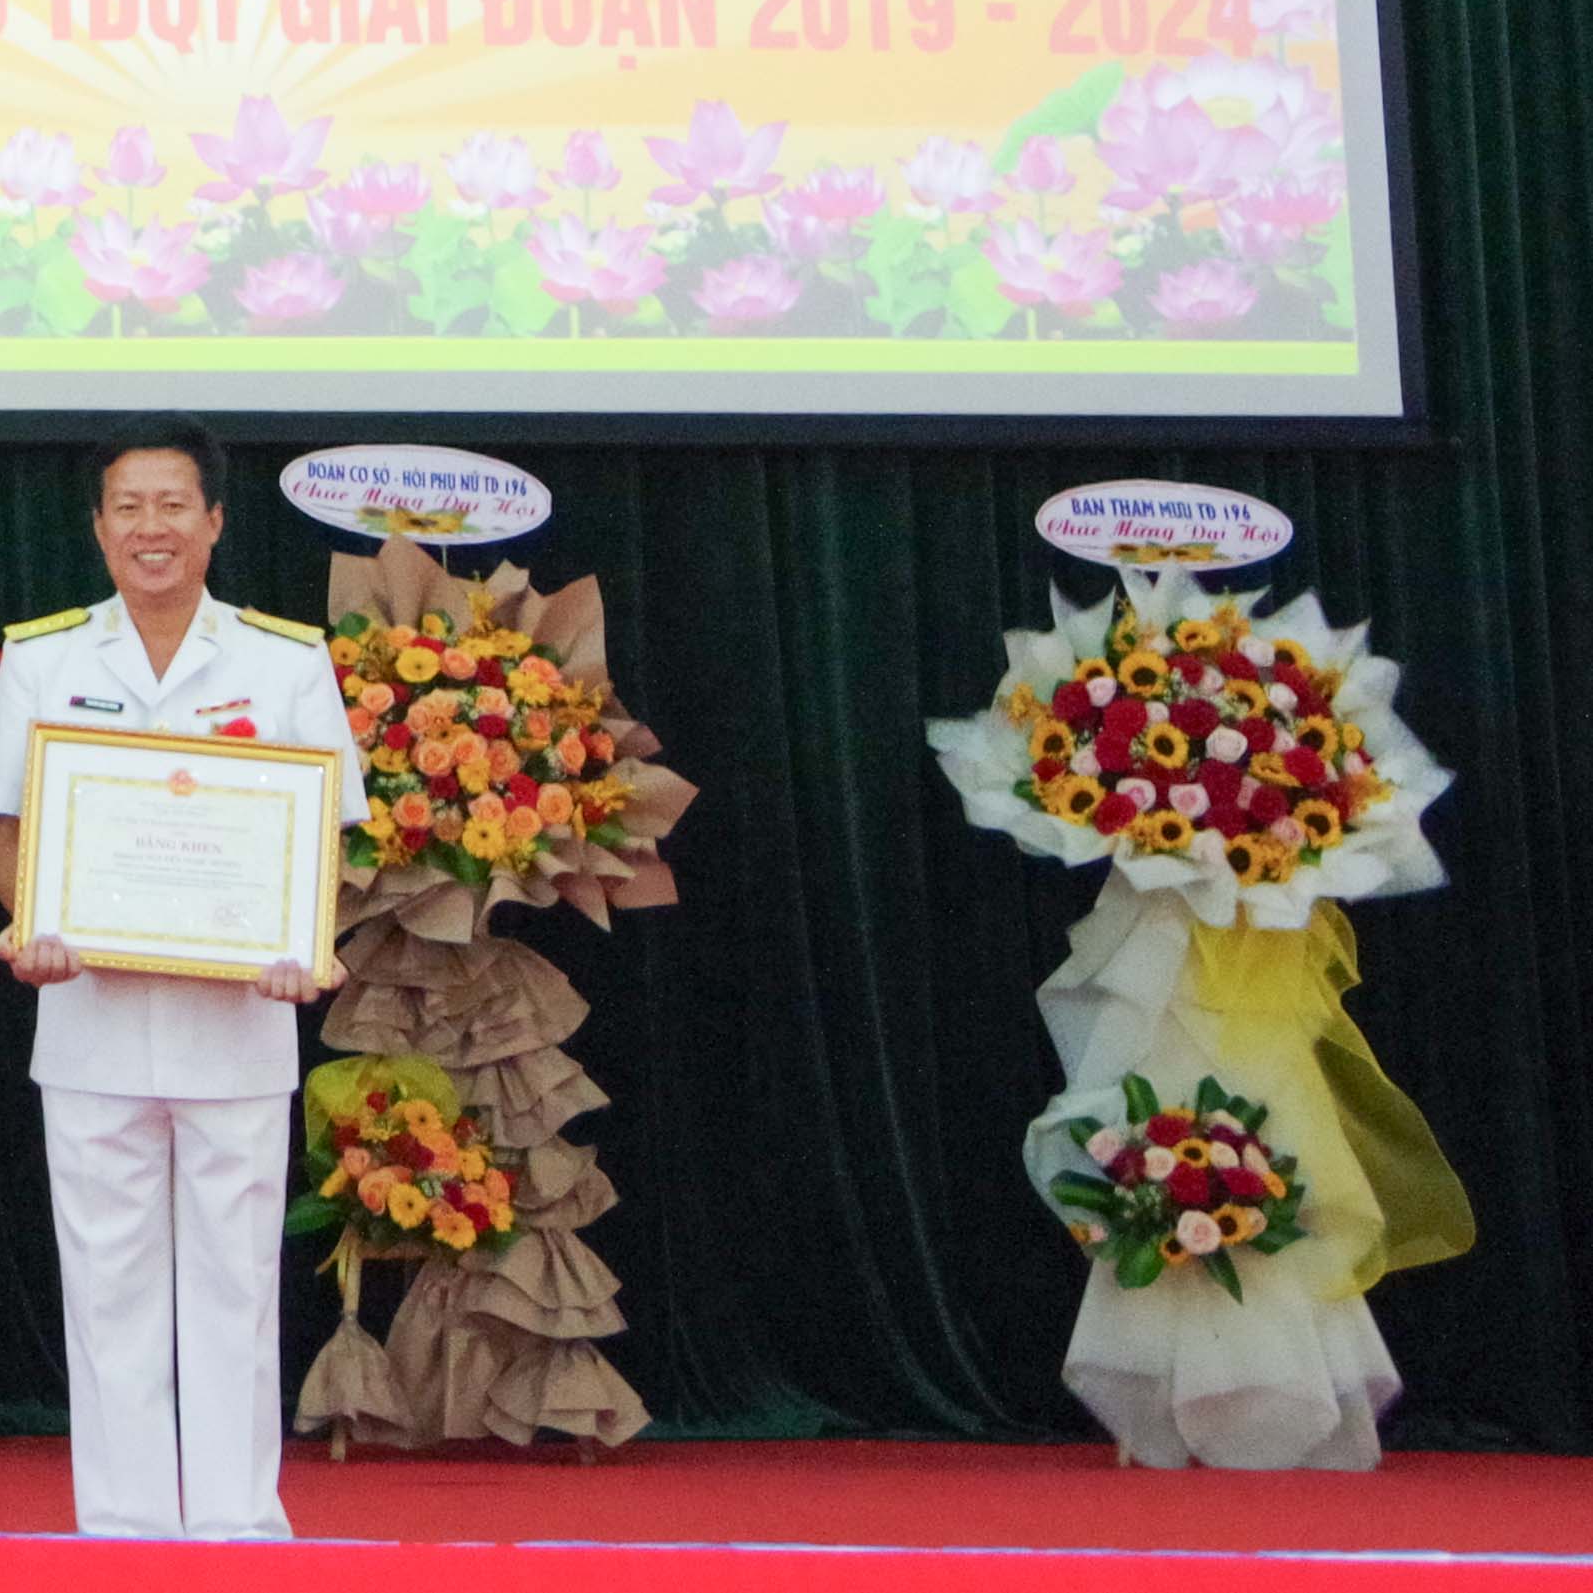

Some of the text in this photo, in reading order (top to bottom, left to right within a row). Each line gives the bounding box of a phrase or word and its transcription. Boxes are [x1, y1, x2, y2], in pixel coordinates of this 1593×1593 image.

[505, 476, 528, 497] 196
[1071, 497, 1105, 517] BAN
[1109, 498, 1155, 520] THAM
[1223, 503, 1251, 522] 196
